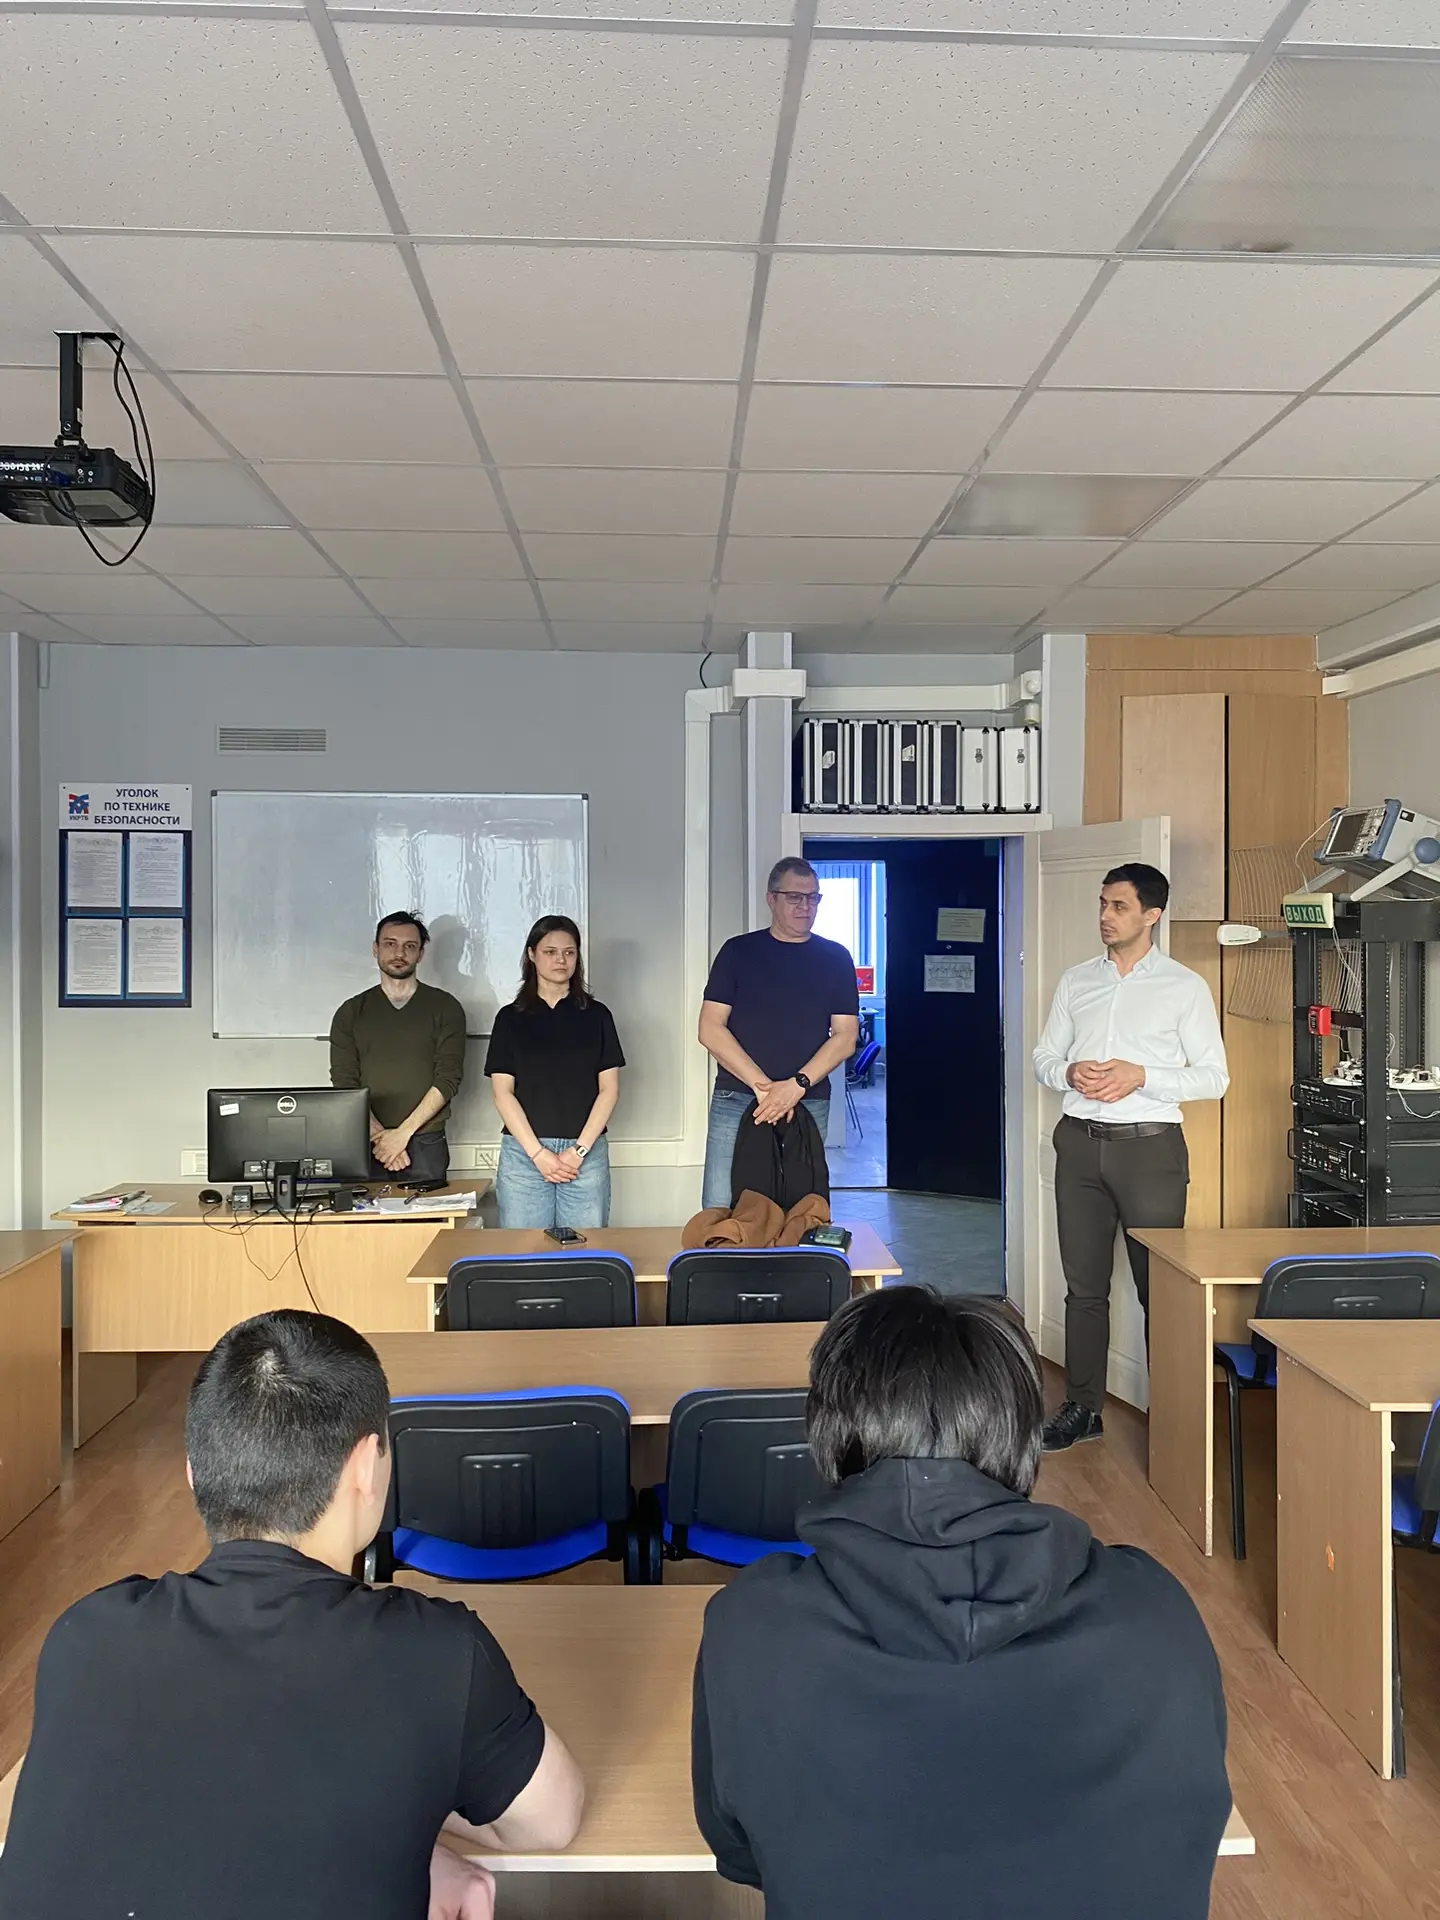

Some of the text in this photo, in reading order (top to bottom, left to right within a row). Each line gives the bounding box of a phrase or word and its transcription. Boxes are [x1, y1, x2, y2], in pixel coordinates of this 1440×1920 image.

[115, 788, 159, 798] УГОЛОК
[104, 802, 171, 812] ПО ТЕХНИКЕ
[94, 815, 181, 825] БЕЗОПАСНОСТИ
[1286, 906, 1324, 922] ВЫХОД
